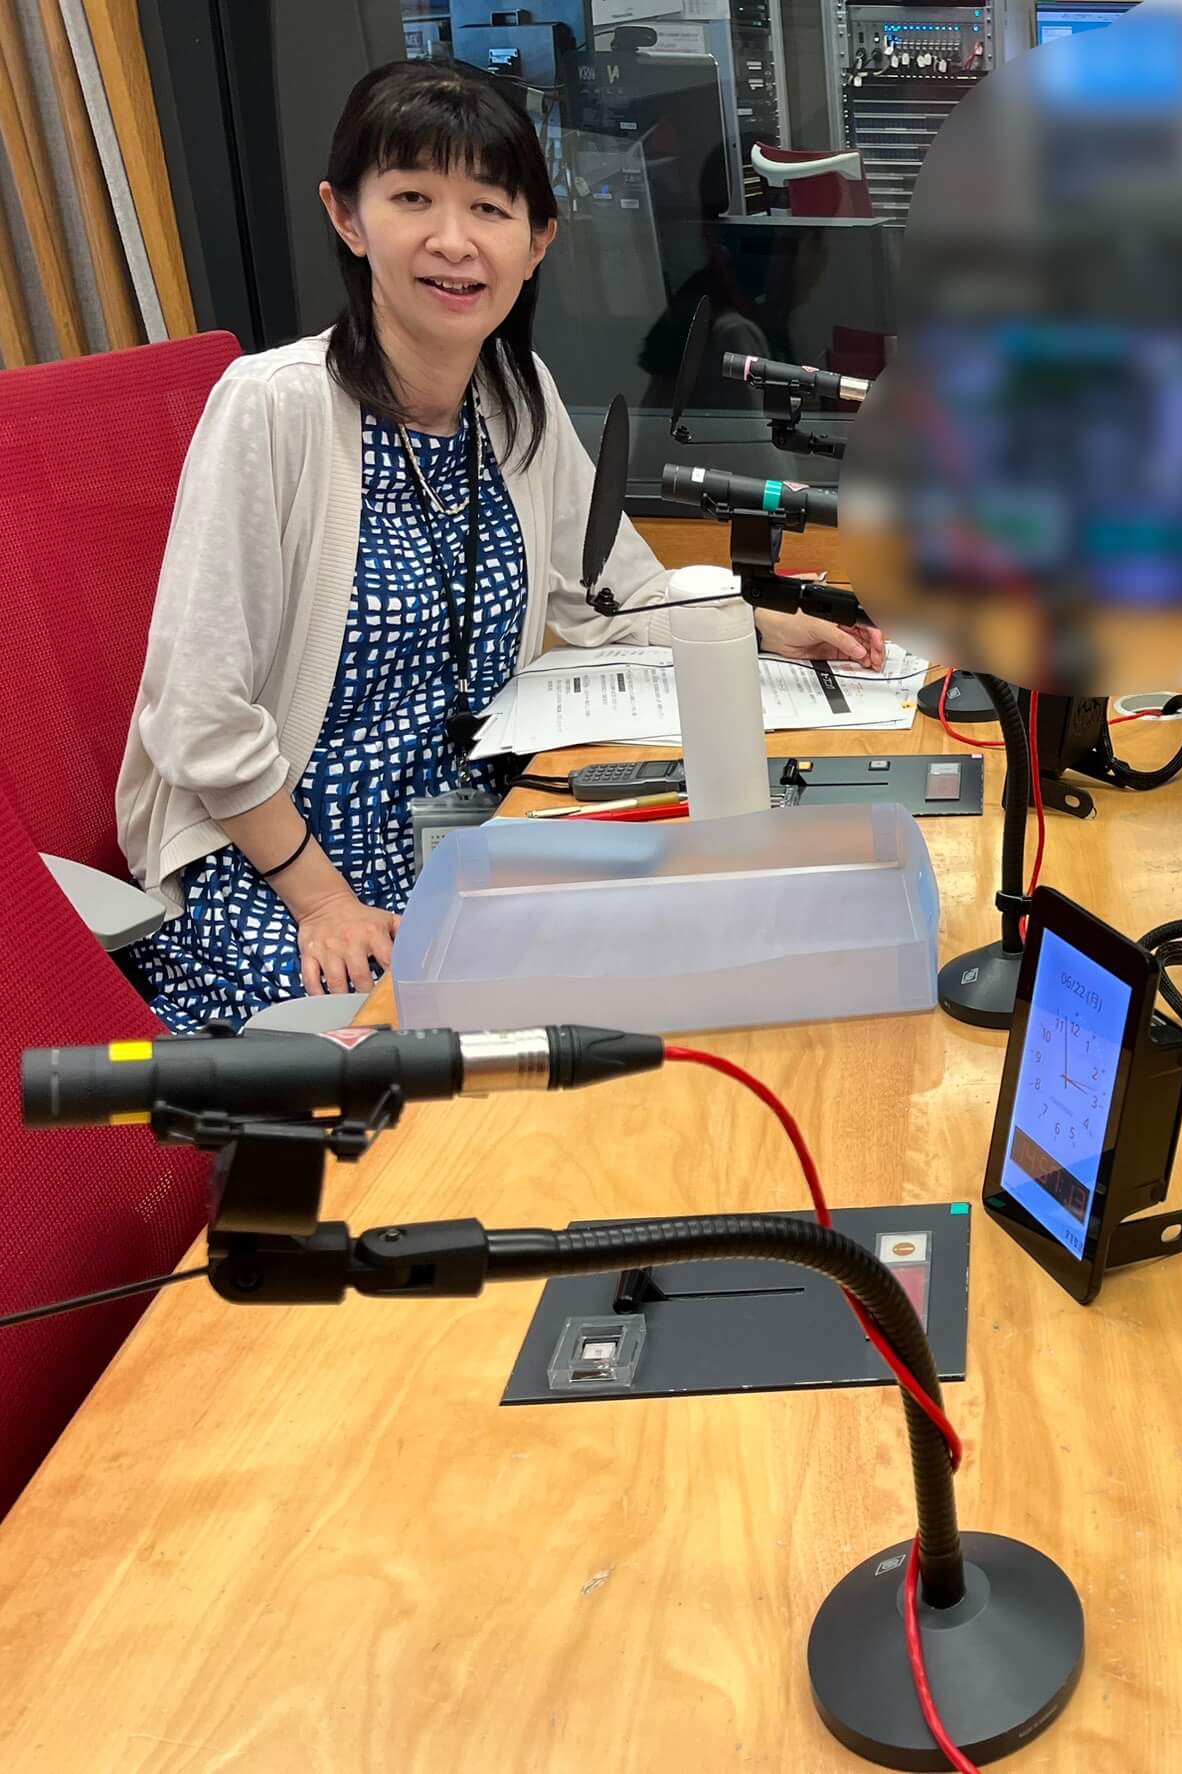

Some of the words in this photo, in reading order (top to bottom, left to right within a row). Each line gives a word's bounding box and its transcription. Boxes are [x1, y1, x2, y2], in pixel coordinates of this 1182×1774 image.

[1042, 1027, 1052, 1043] 10
[1071, 1021, 1080, 1038] 12
[1034, 1077, 1041, 1090] 8
[1055, 1122, 1061, 1135] 6
